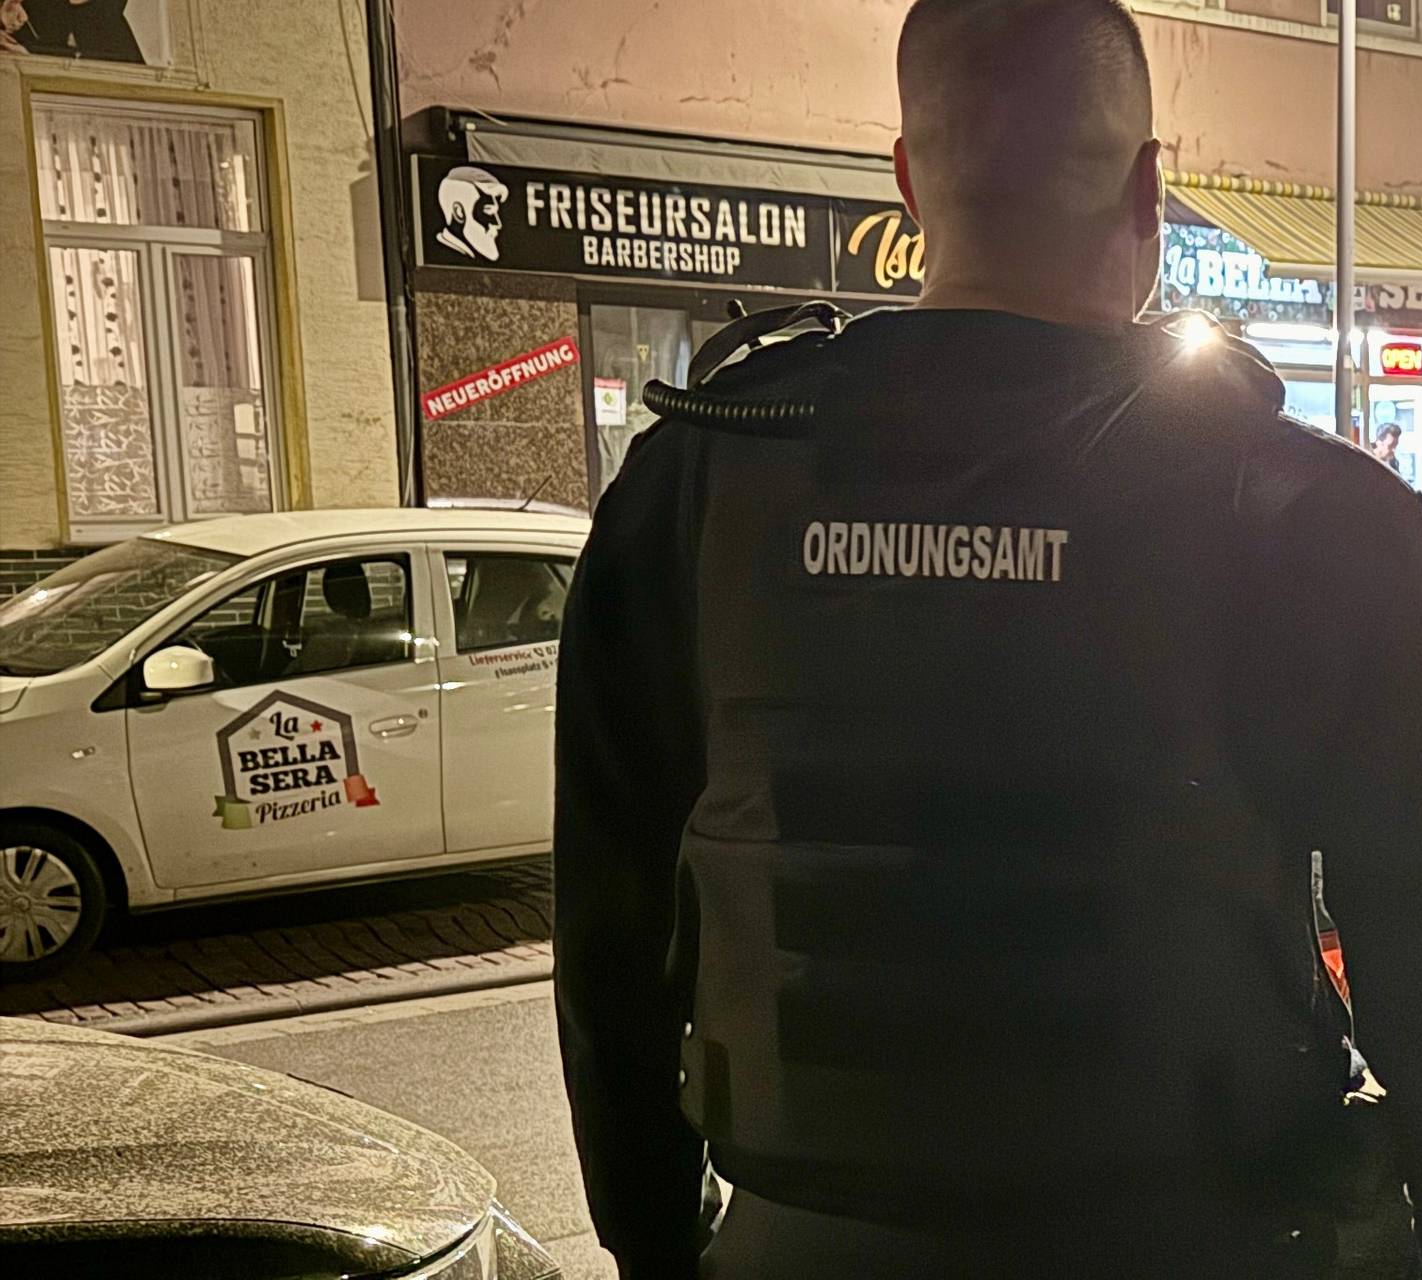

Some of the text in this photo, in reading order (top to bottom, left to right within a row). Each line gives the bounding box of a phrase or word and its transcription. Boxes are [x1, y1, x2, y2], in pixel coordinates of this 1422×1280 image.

[527, 181, 807, 248] FRISEURSALON
[582, 235, 740, 275] BARBERSHOP
[1163, 245, 1196, 297] La
[1381, 348, 1422, 371] OPEN
[427, 343, 574, 416] NEUERÖFFNUNG
[803, 521, 1069, 581] ORDNUNGSAMT
[269, 711, 299, 741] La
[238, 740, 341, 772] BELLA
[250, 765, 338, 795] SERA
[255, 790, 341, 823] Pizzeria
